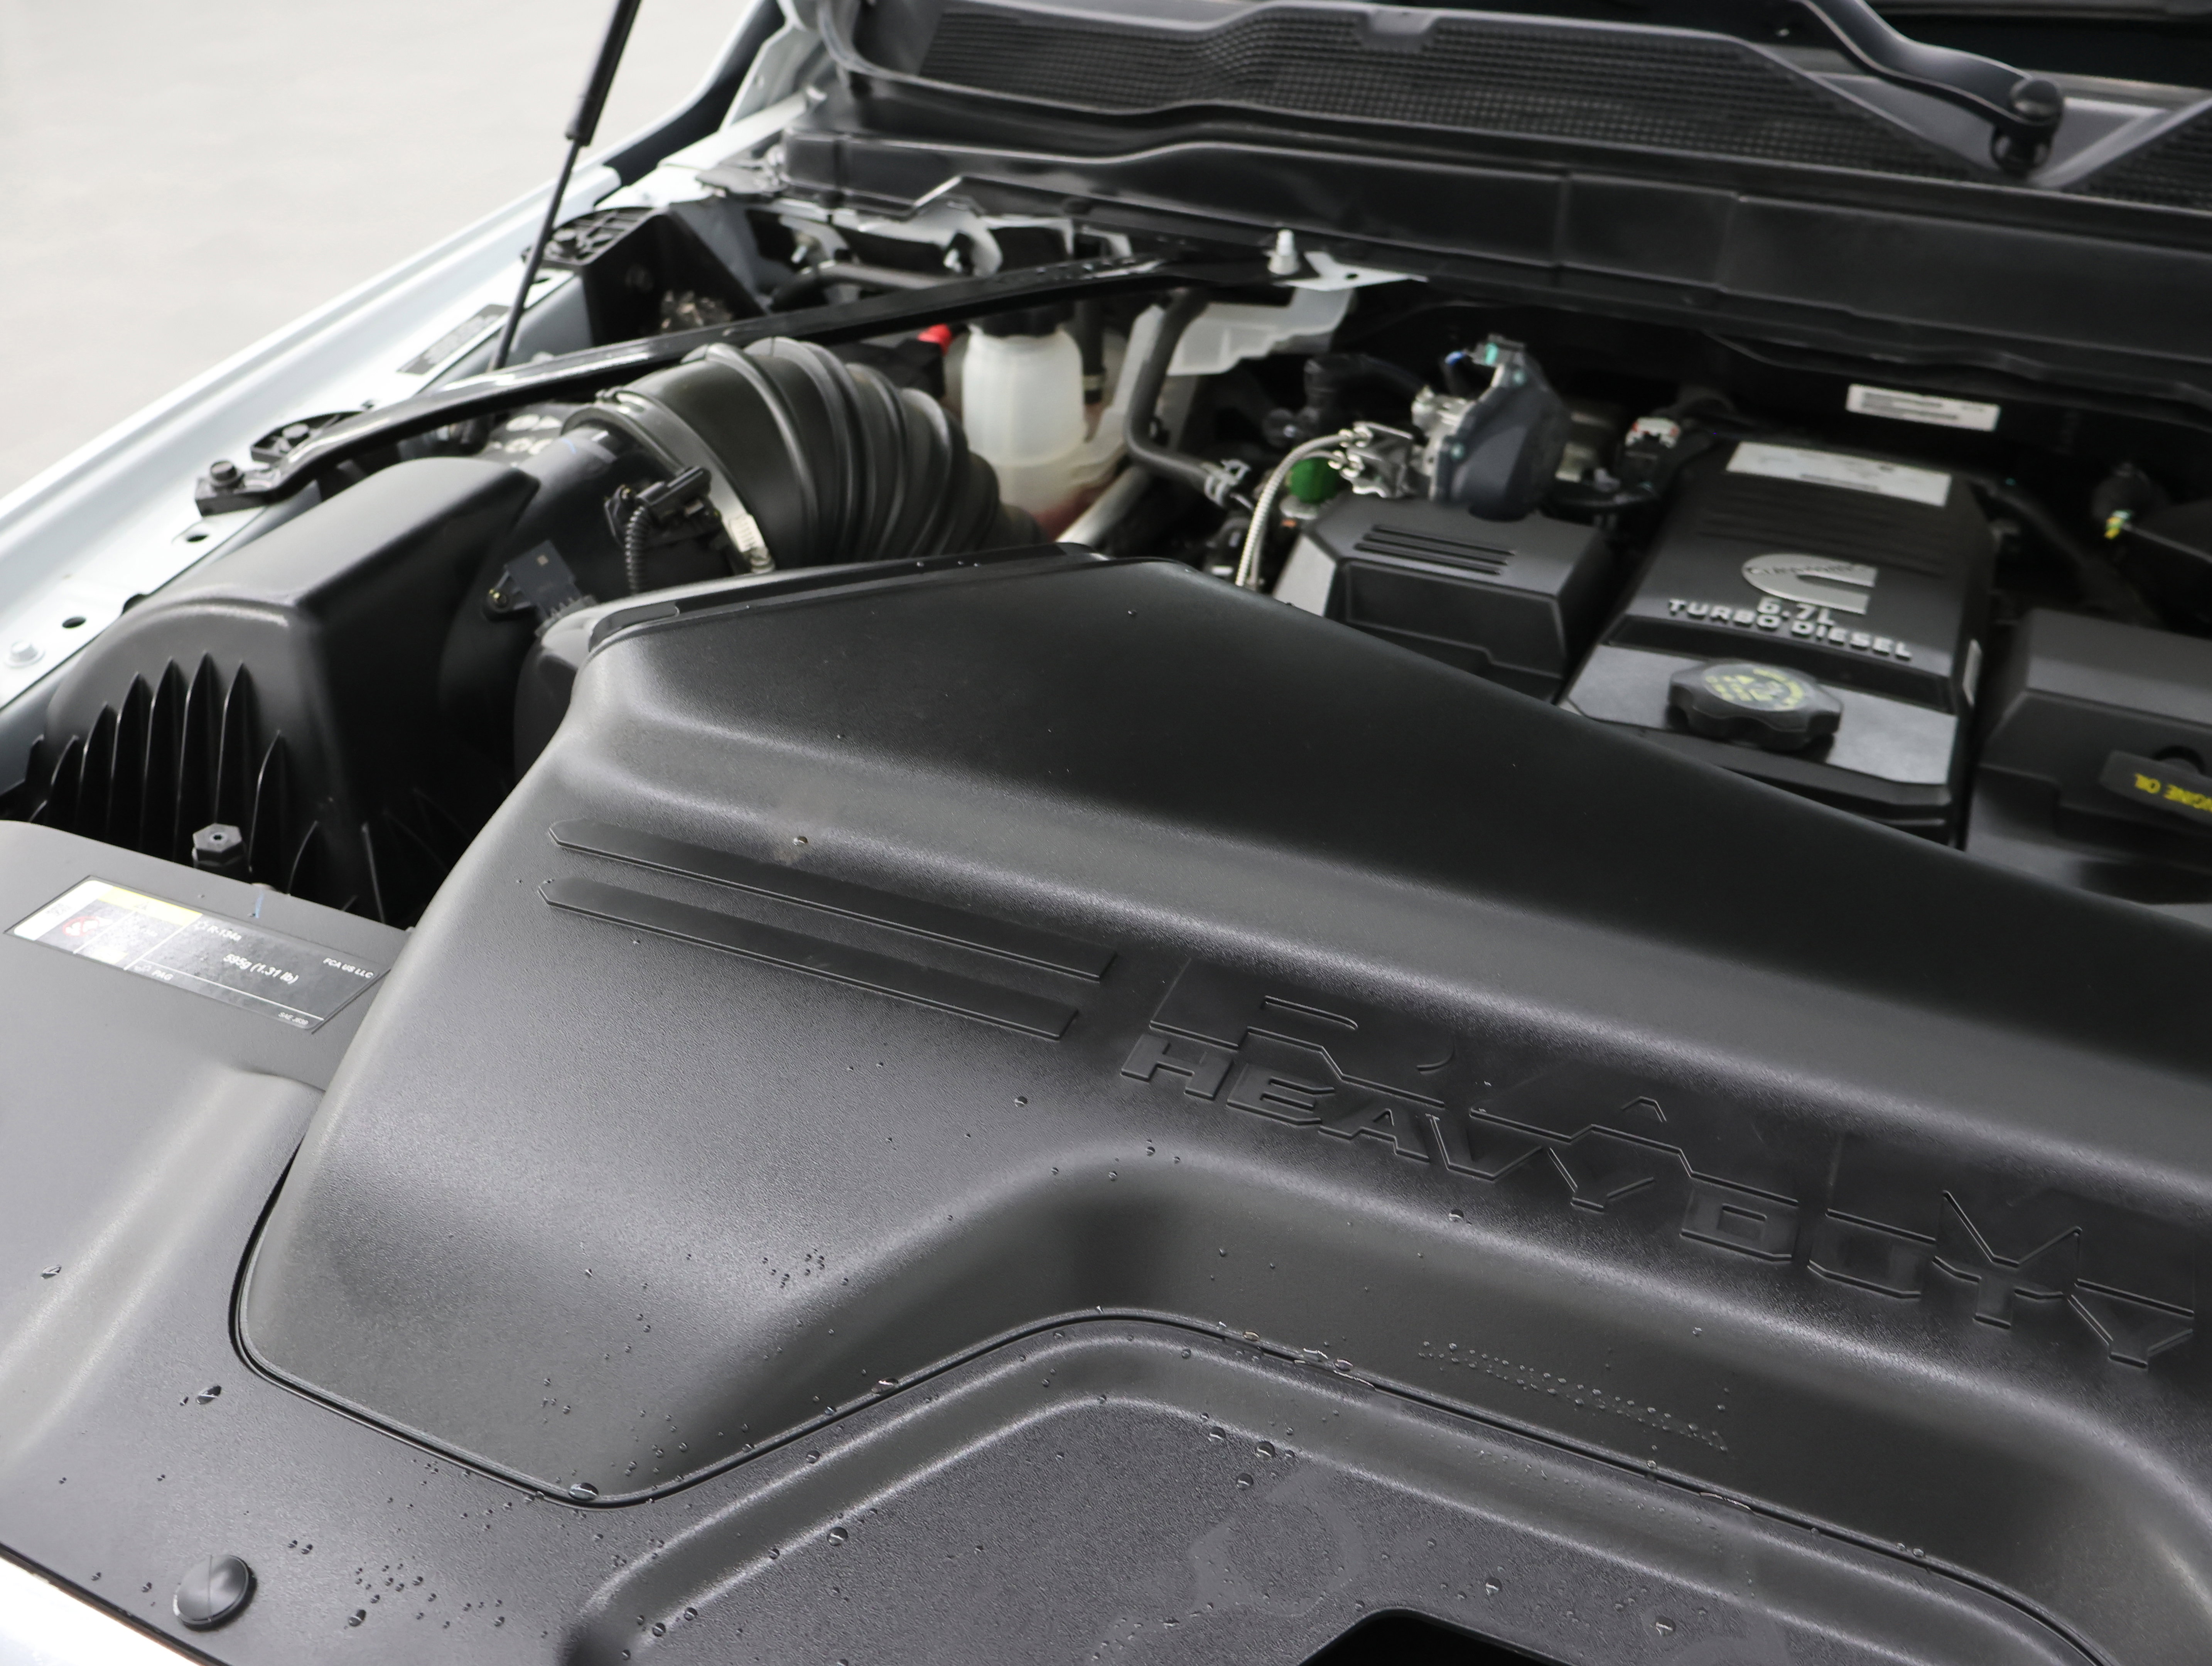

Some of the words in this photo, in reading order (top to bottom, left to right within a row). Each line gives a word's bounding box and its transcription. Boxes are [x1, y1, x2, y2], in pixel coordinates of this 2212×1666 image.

[1757, 596, 1835, 627] 6.7L
[1669, 598, 1781, 630] TURBO
[1790, 618, 1912, 659] DIESEL
[2164, 784, 2212, 813] NGINE
[151, 970, 174, 981] PAG
[223, 953, 252, 970] 595g
[250, 963, 282, 977] (1.31
[279, 971, 299, 984] lb)
[323, 958, 342, 968] FCA
[341, 964, 356, 972] US
[354, 968, 374, 979] LLC
[1121, 1034, 1655, 1212] HEAVY
[1680, 1172, 2195, 1369] DUTY
